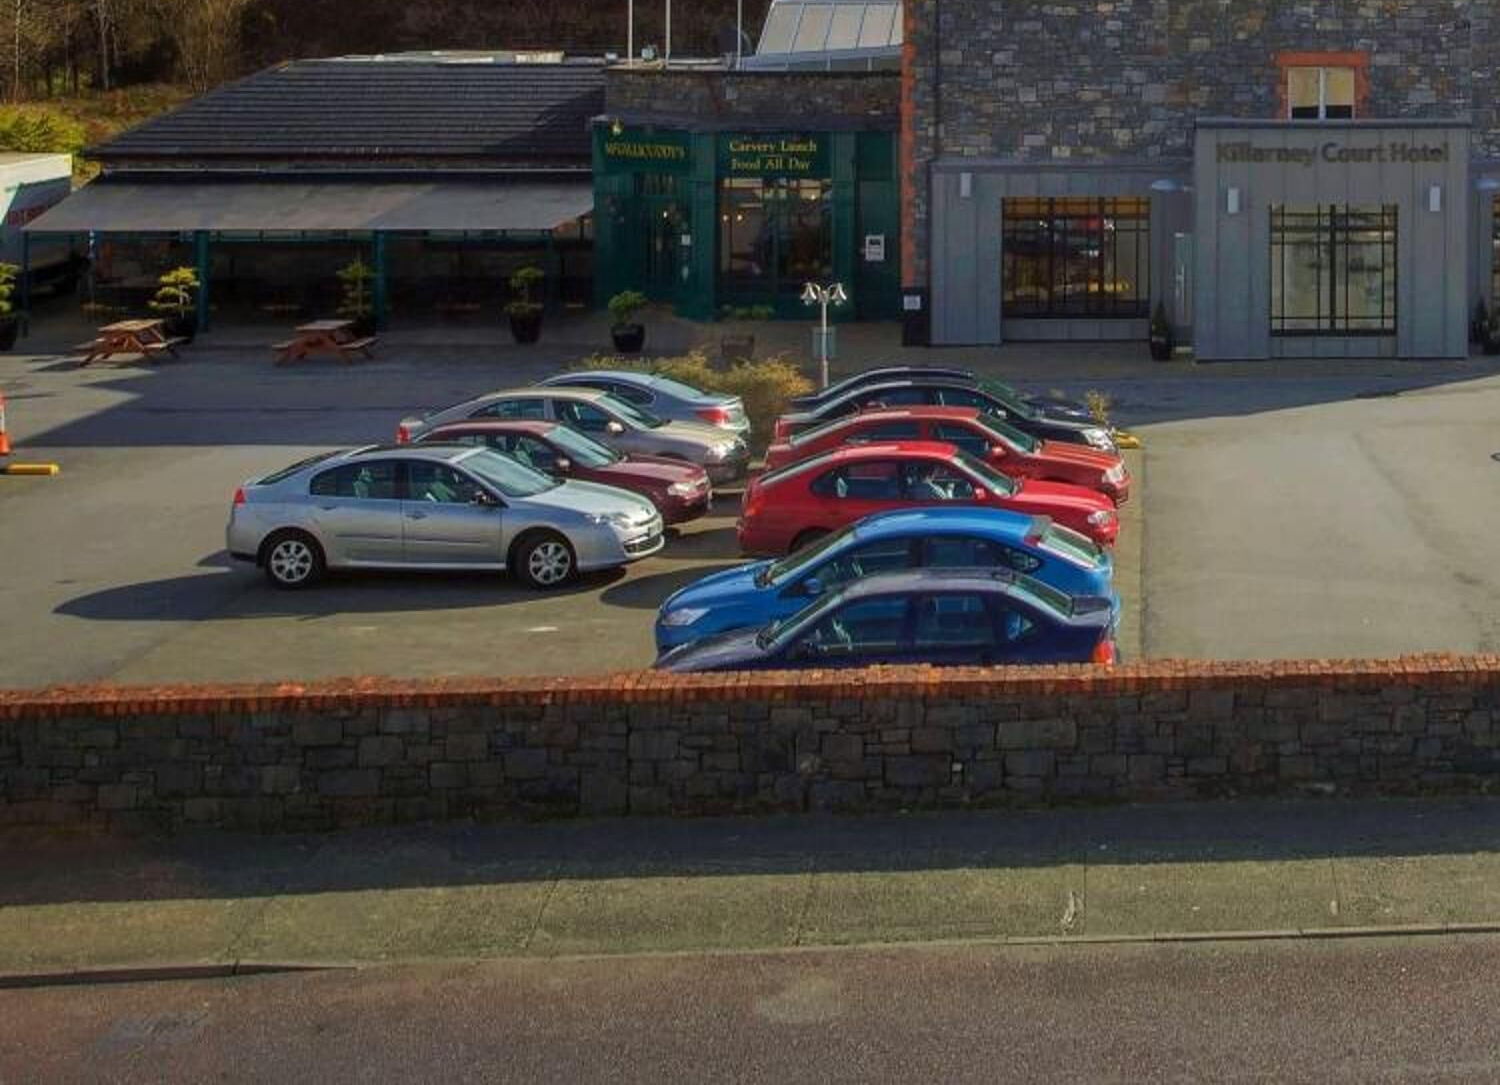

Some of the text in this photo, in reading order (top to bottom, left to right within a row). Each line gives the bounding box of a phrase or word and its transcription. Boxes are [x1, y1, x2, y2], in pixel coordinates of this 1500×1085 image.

[729, 138, 817, 155] Carvery Lunch
[1216, 141, 1449, 168] Killarney Court Hotel
[731, 158, 761, 171] Food
[766, 157, 783, 171] All
